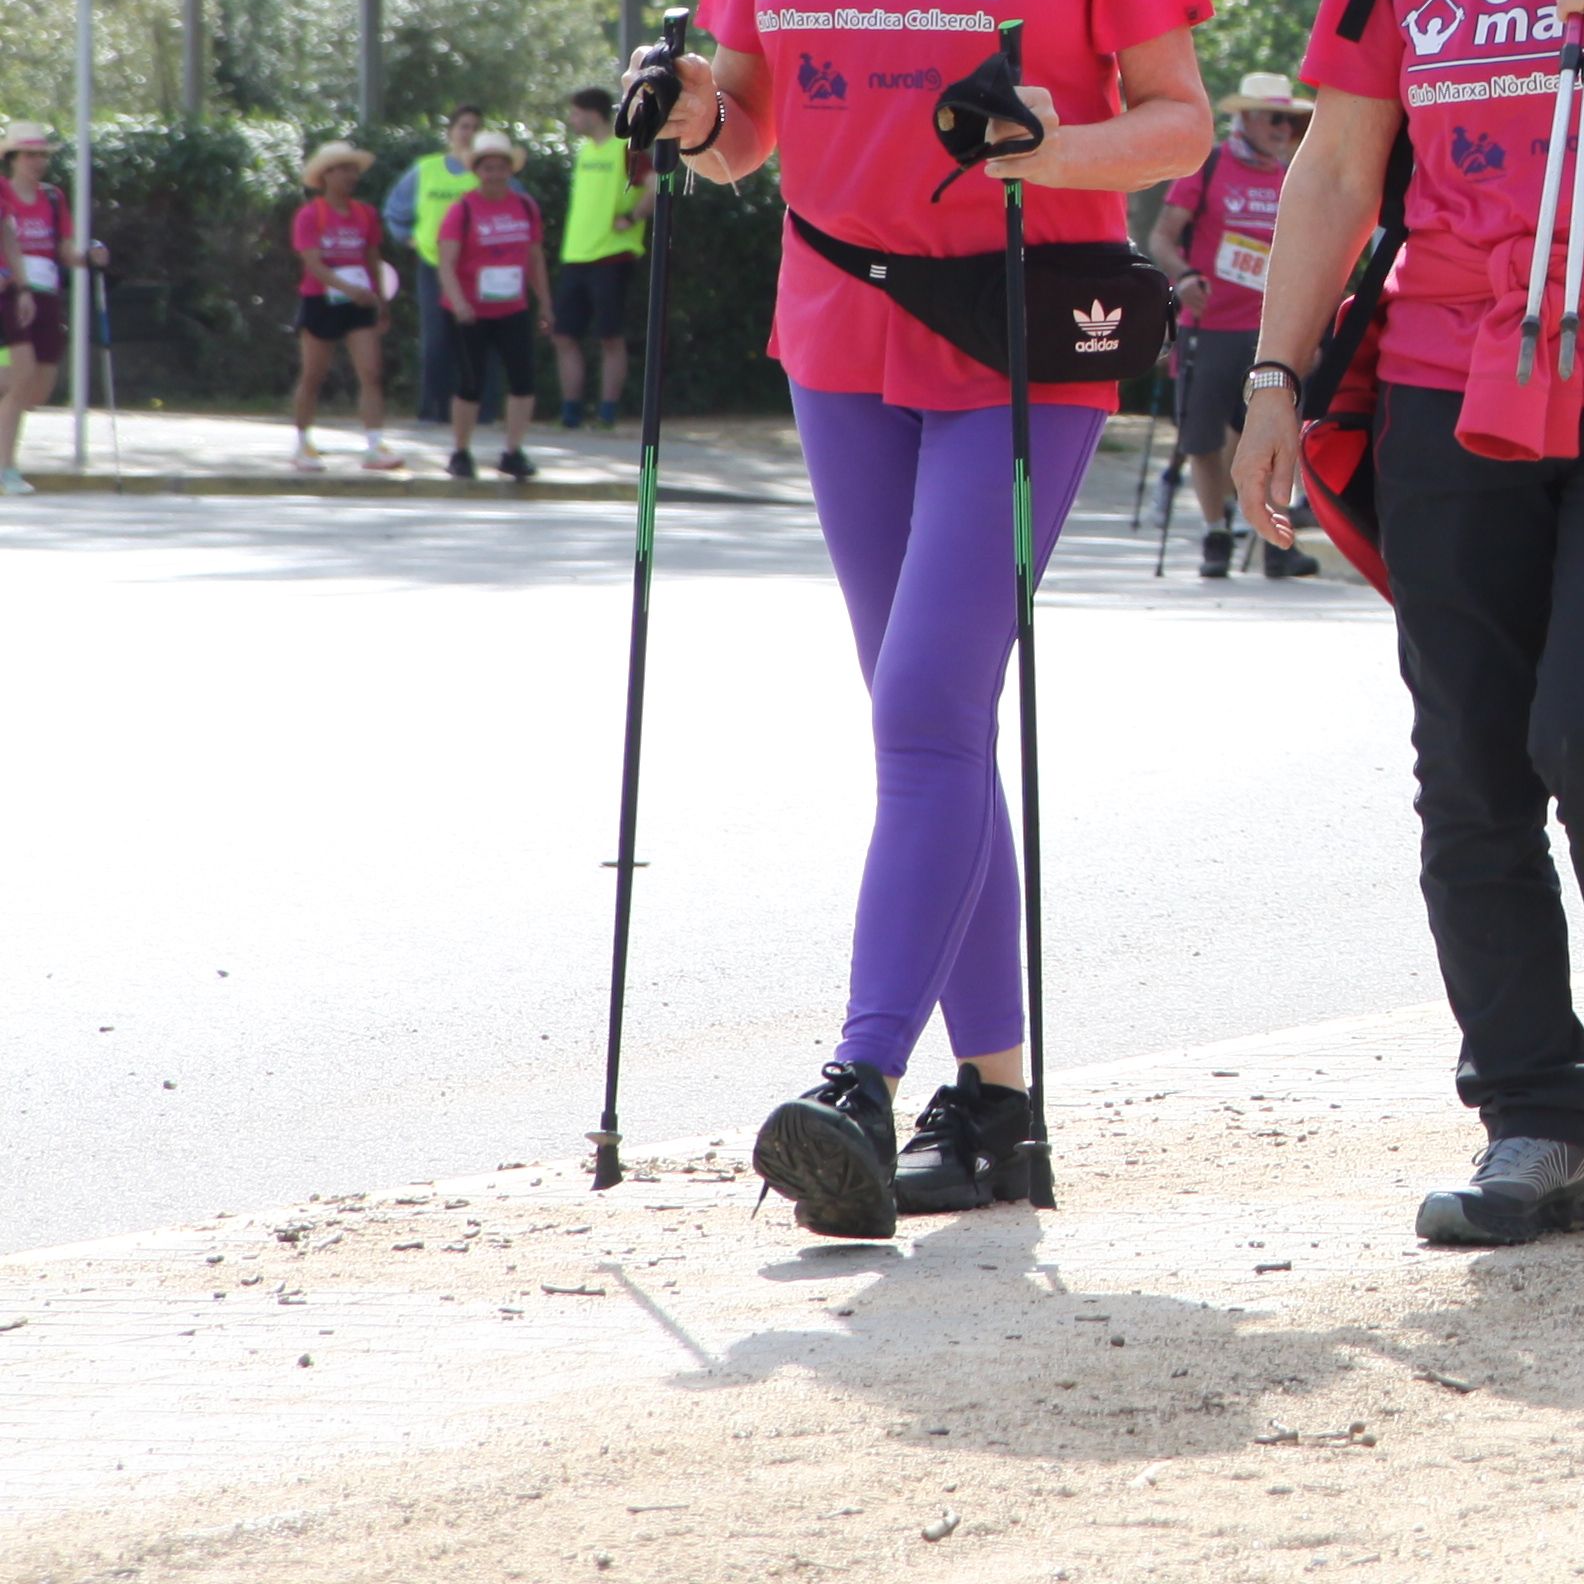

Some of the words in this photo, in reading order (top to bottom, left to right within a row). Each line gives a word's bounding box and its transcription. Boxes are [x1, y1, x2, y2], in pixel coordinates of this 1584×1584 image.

[780, 8, 831, 29] Marxa
[836, 8, 902, 29] Nòrdica
[904, 10, 995, 32] Collserola
[1436, 80, 1489, 102] Marxa
[1075, 337, 1120, 352] adidas
